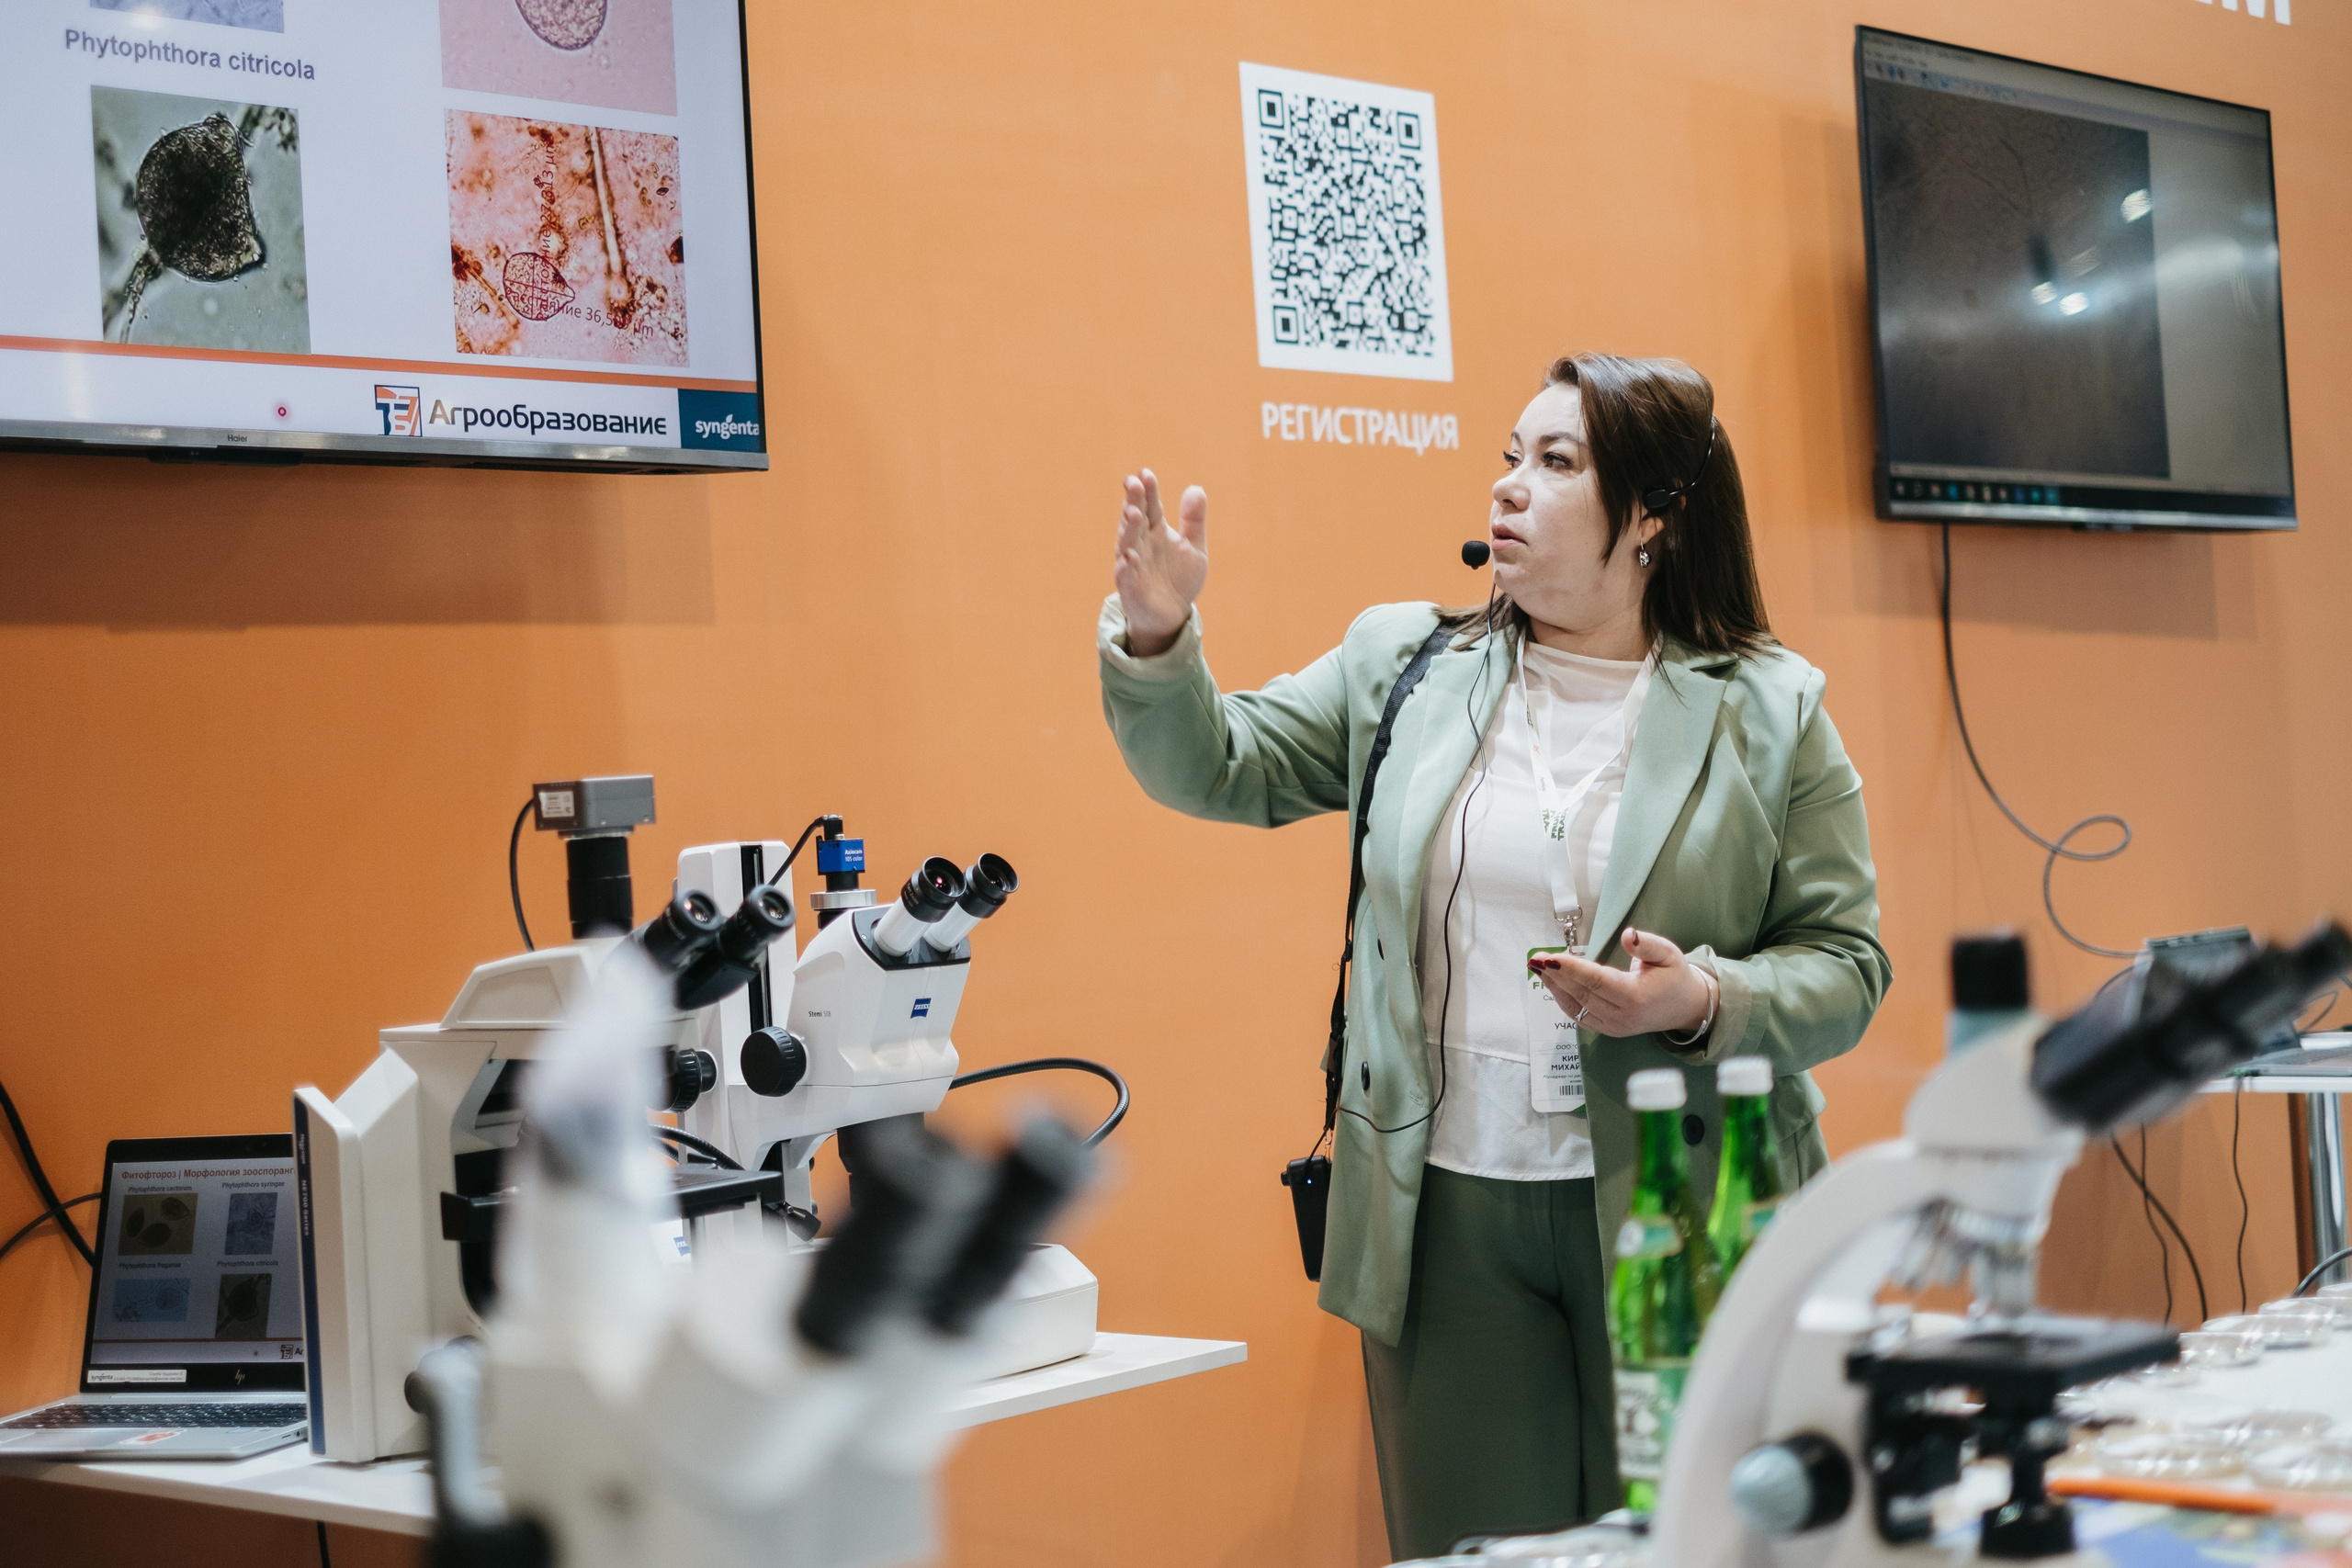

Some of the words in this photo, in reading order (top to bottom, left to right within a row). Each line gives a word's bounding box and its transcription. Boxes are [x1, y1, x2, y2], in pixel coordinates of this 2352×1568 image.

[65, 28, 221, 69] Phytophthora
[229, 51, 315, 80] citricola
[428, 400, 667, 436] Агрообразование
[695, 413, 760, 440] syngenta
[1261, 401, 1460, 457] РЕГИСТРАЦИЯ
[227, 434, 248, 442] Haier
[121, 1170, 176, 1180] Фитофтороз
[184, 1168, 240, 1179] Морфология
[129, 1185, 165, 1193] Phytophthora
[221, 1181, 260, 1190] Phytophthora
[234, 1369, 245, 1385] hp
